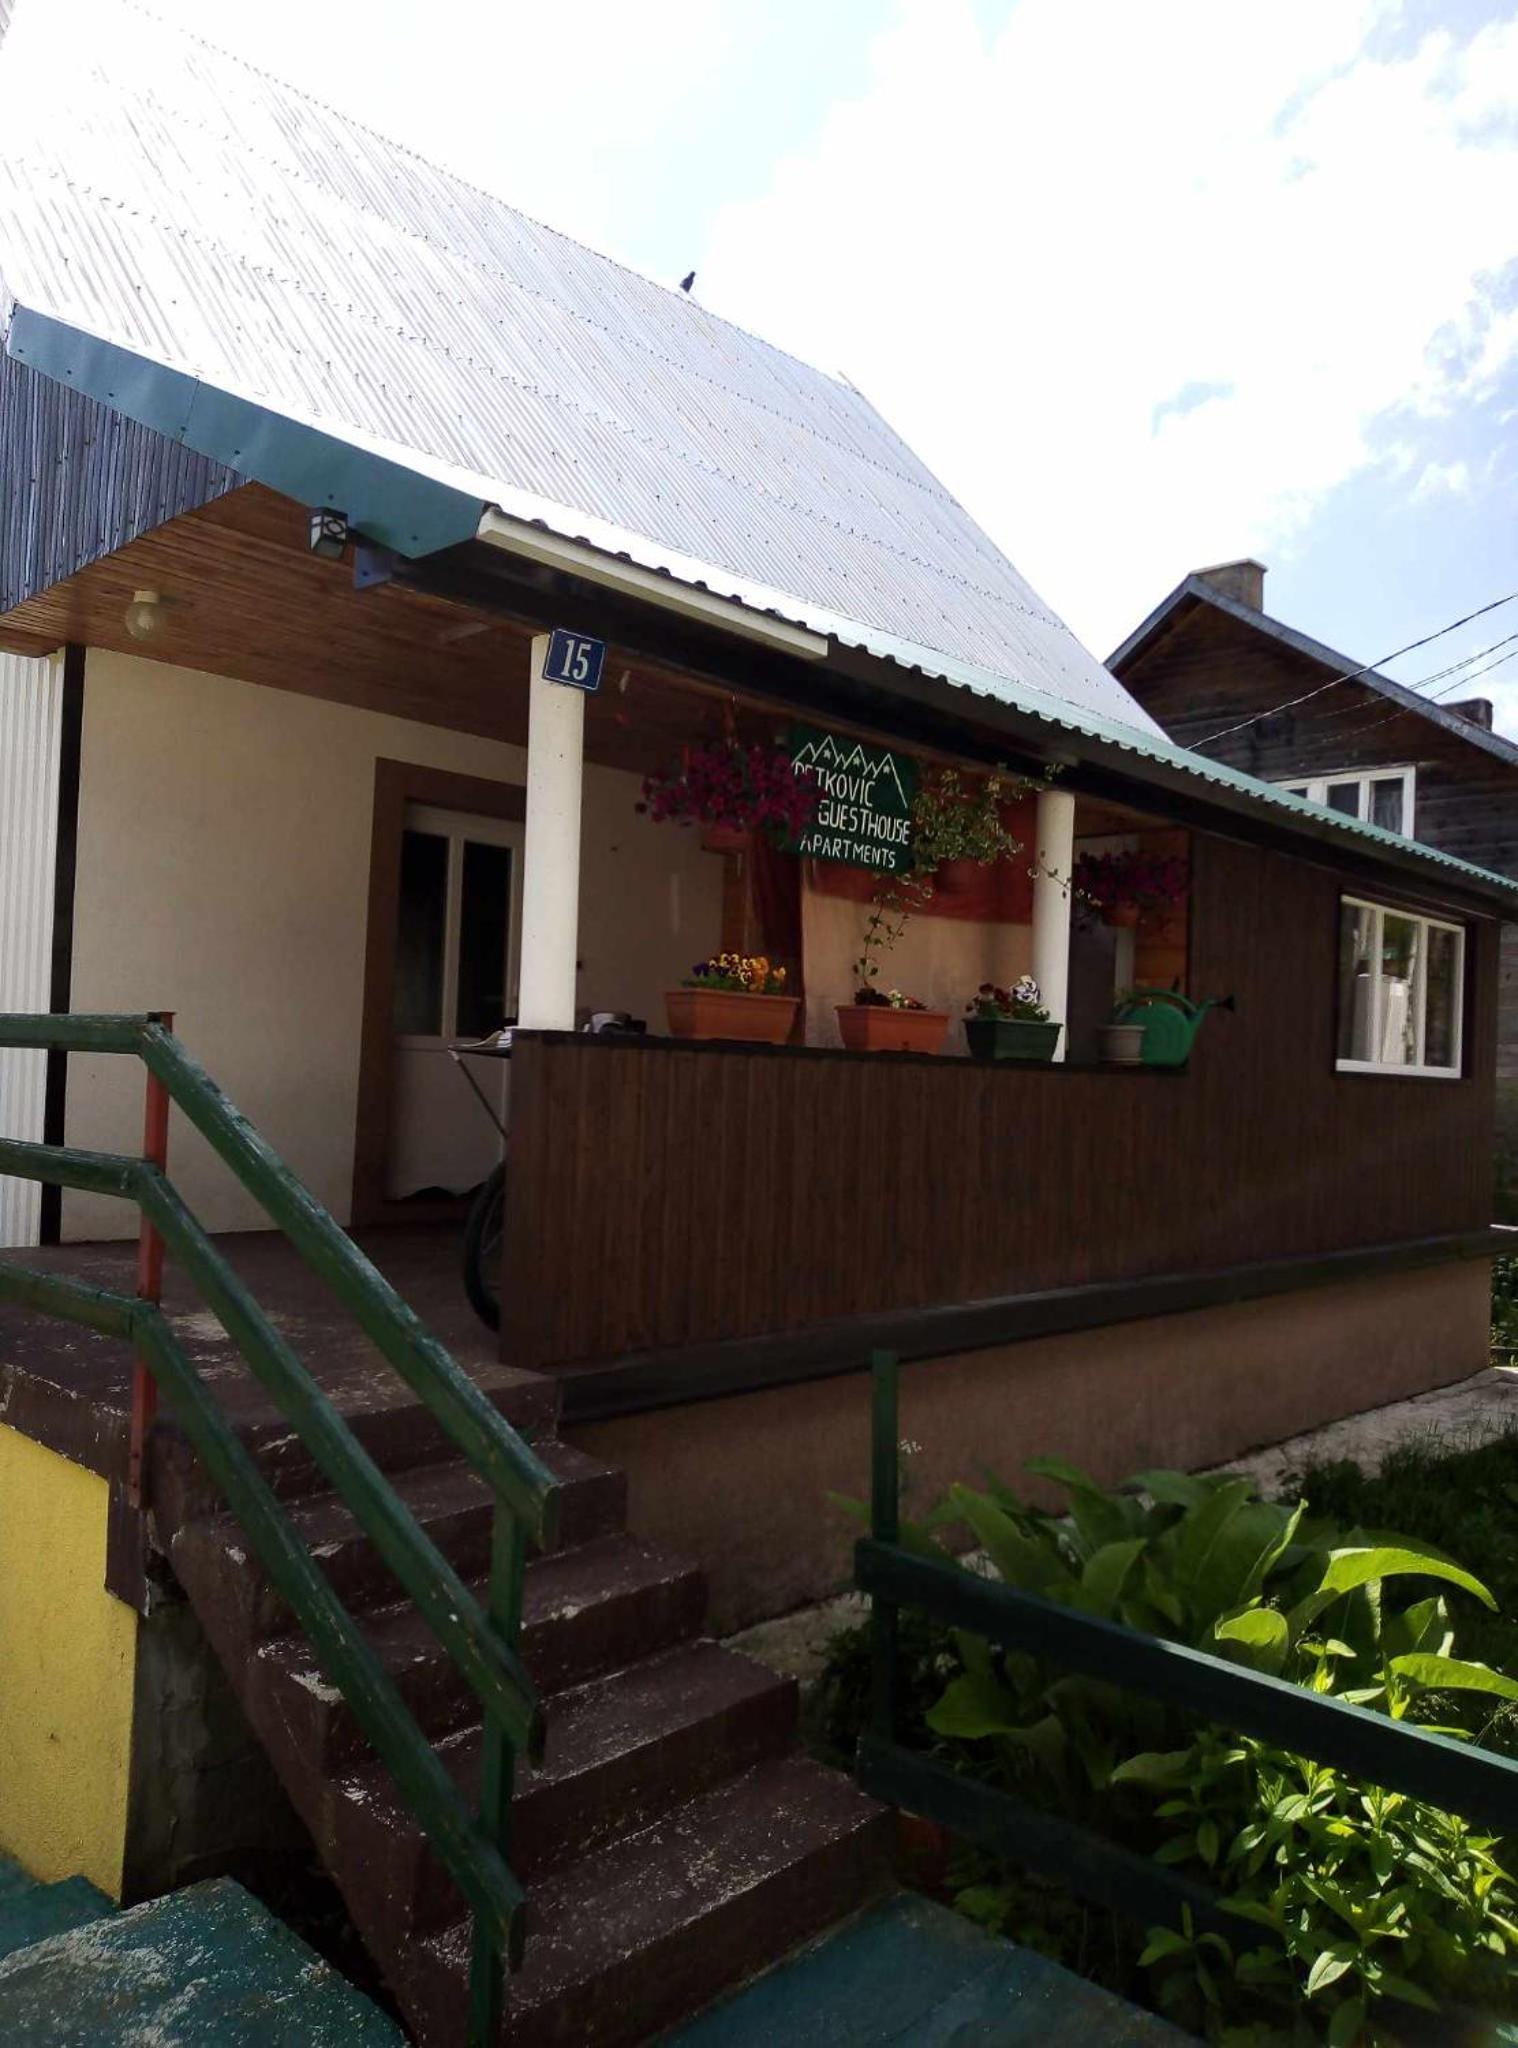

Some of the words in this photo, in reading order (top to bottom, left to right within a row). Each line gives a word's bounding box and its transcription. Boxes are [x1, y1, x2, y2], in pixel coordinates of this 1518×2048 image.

[561, 639, 592, 680] 15
[818, 799, 911, 845] GUESTHOUSE
[800, 833, 896, 869] APARTMENTS
